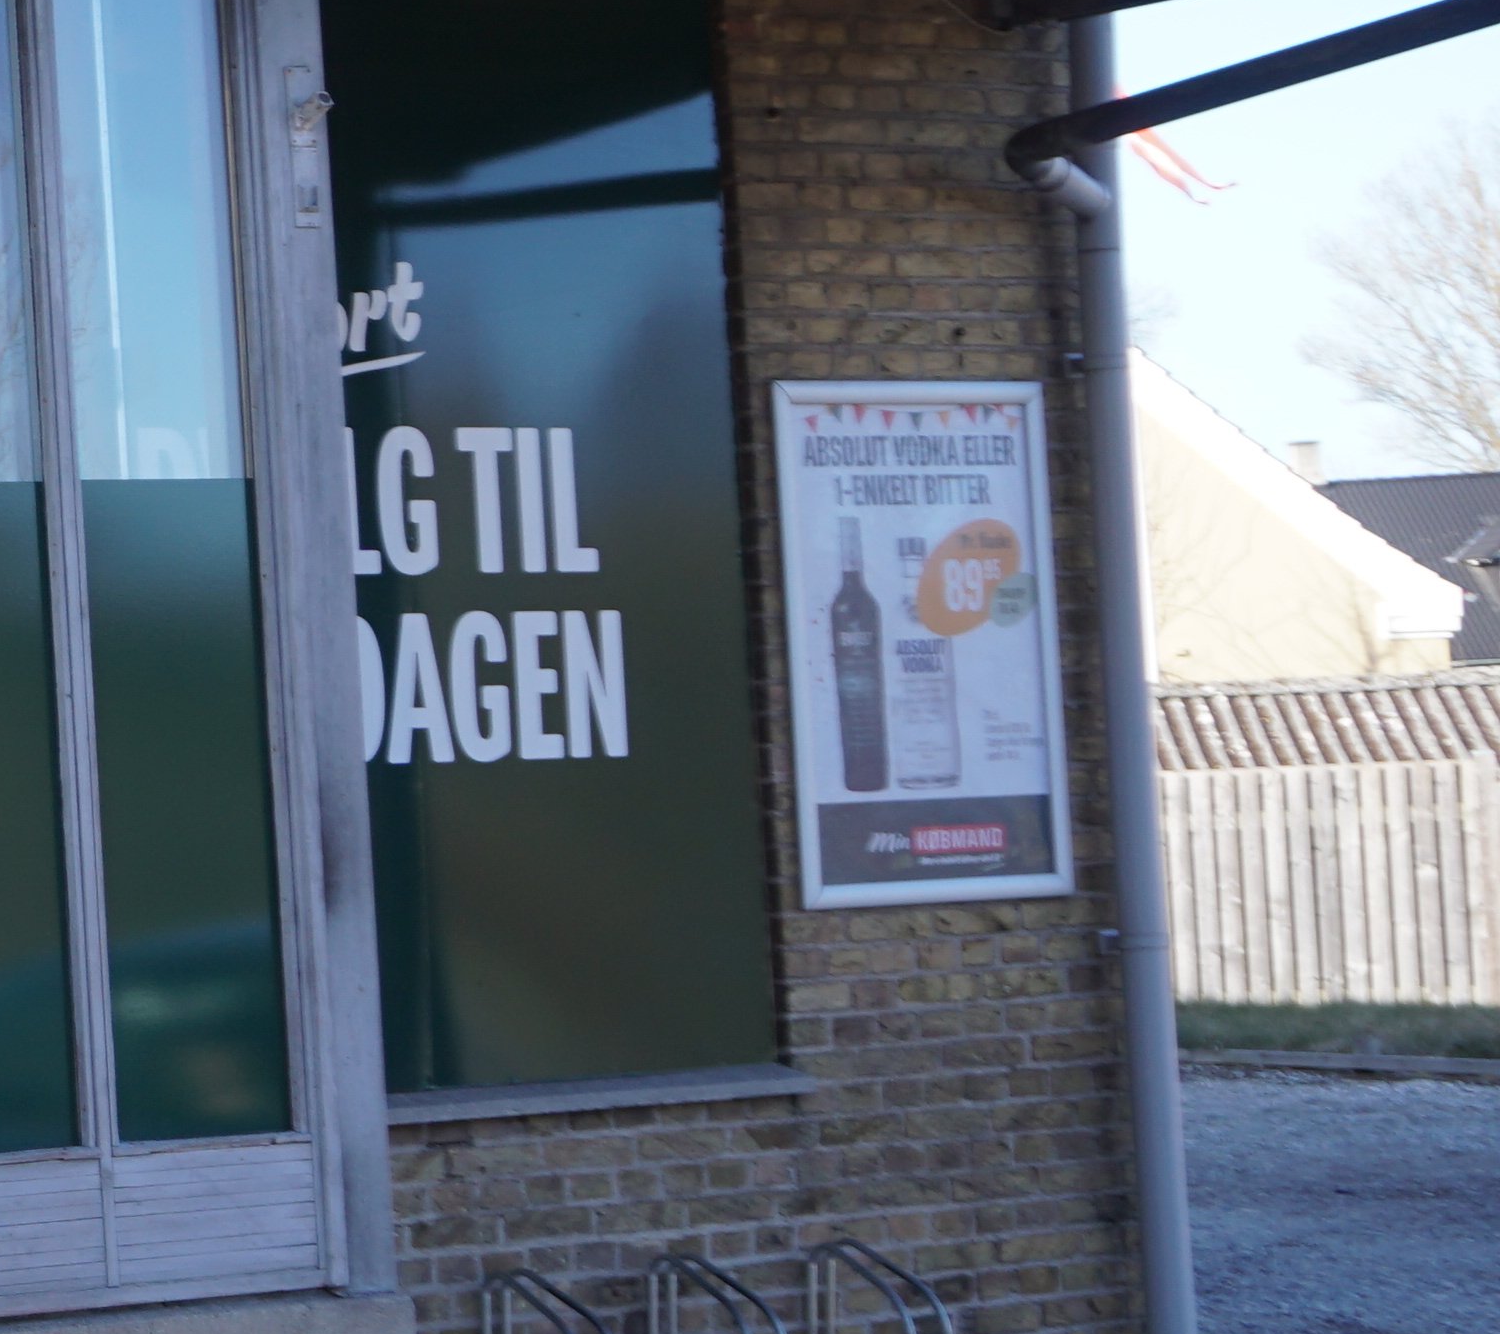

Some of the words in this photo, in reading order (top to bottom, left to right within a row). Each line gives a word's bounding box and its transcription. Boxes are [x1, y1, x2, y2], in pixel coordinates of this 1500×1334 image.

[804, 435, 888, 467] ABSOLUT
[893, 435, 959, 466] VODKA
[962, 434, 1017, 466] ELLER
[455, 427, 599, 574] TIL
[924, 473, 991, 505] BITTER
[897, 639, 946, 656] ABSOLUT
[916, 827, 1003, 850] KØBMAND
